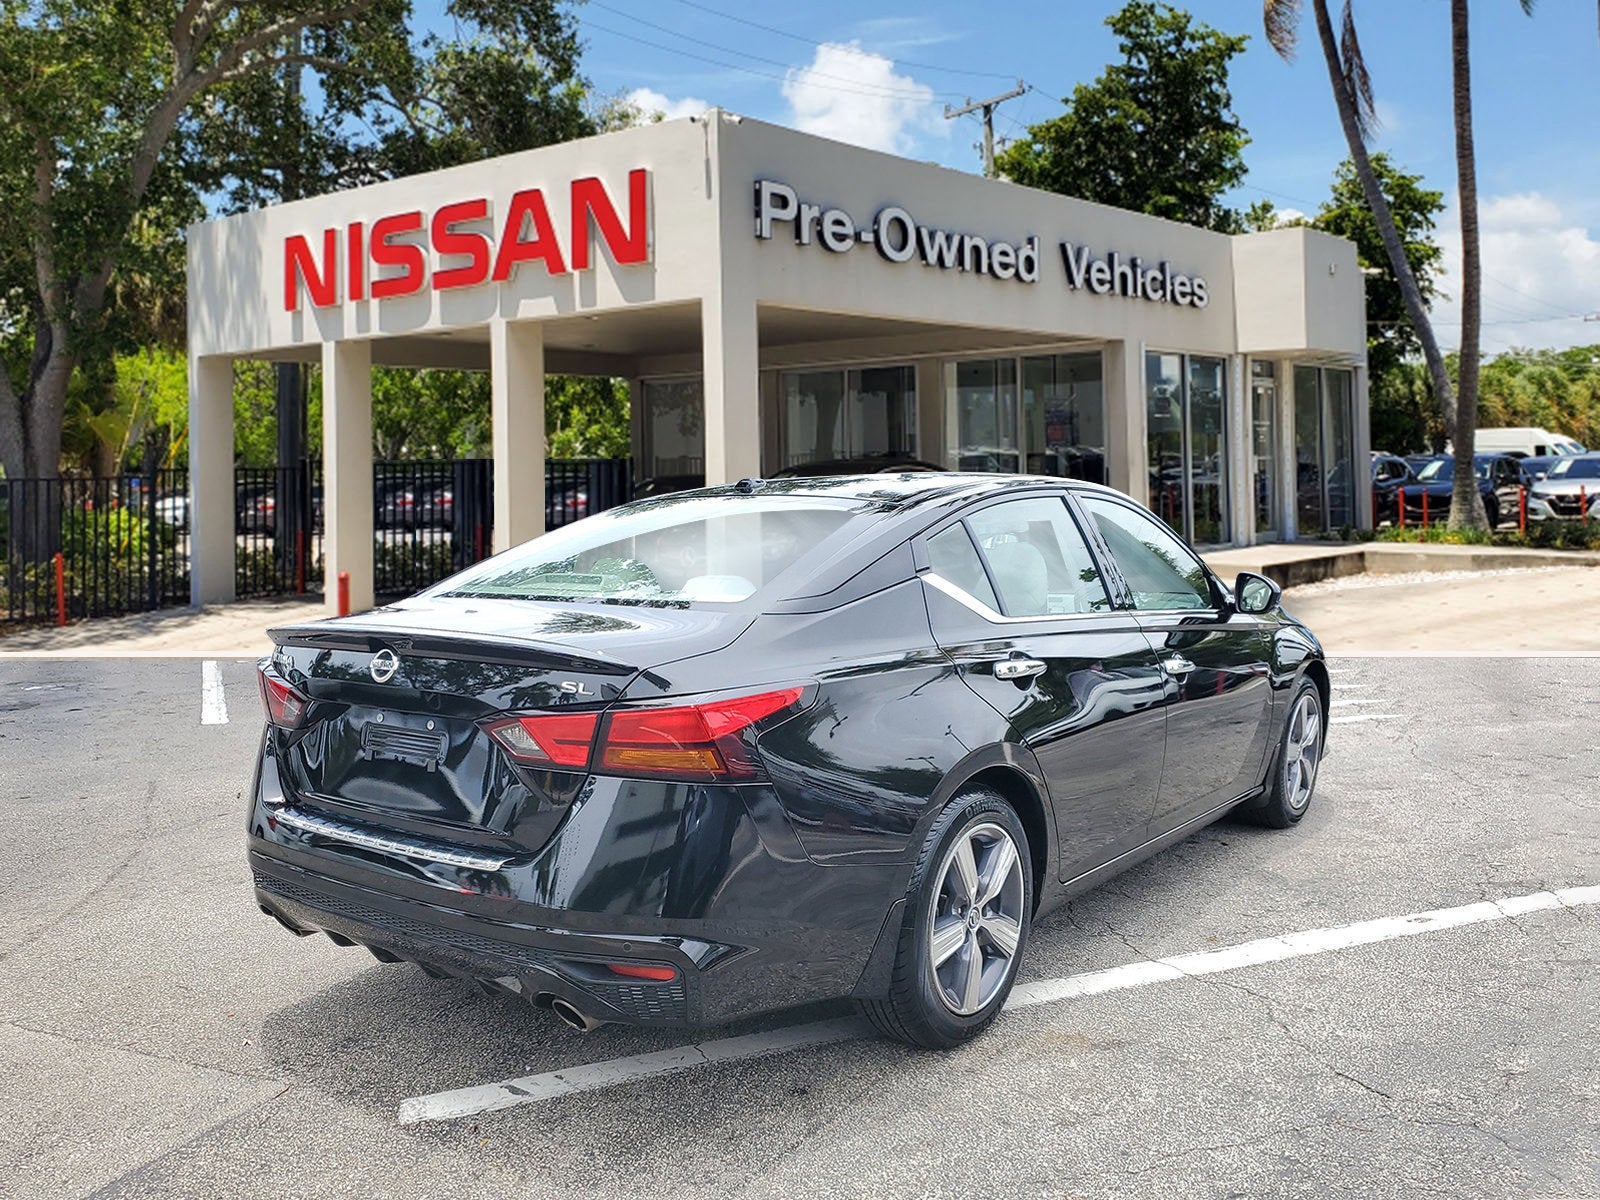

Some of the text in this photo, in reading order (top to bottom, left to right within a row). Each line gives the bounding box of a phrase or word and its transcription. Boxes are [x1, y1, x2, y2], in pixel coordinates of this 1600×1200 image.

[284, 169, 647, 311] NISSAN
[754, 179, 1208, 308] Pre-Owned Vehicles
[560, 681, 595, 696] SL
